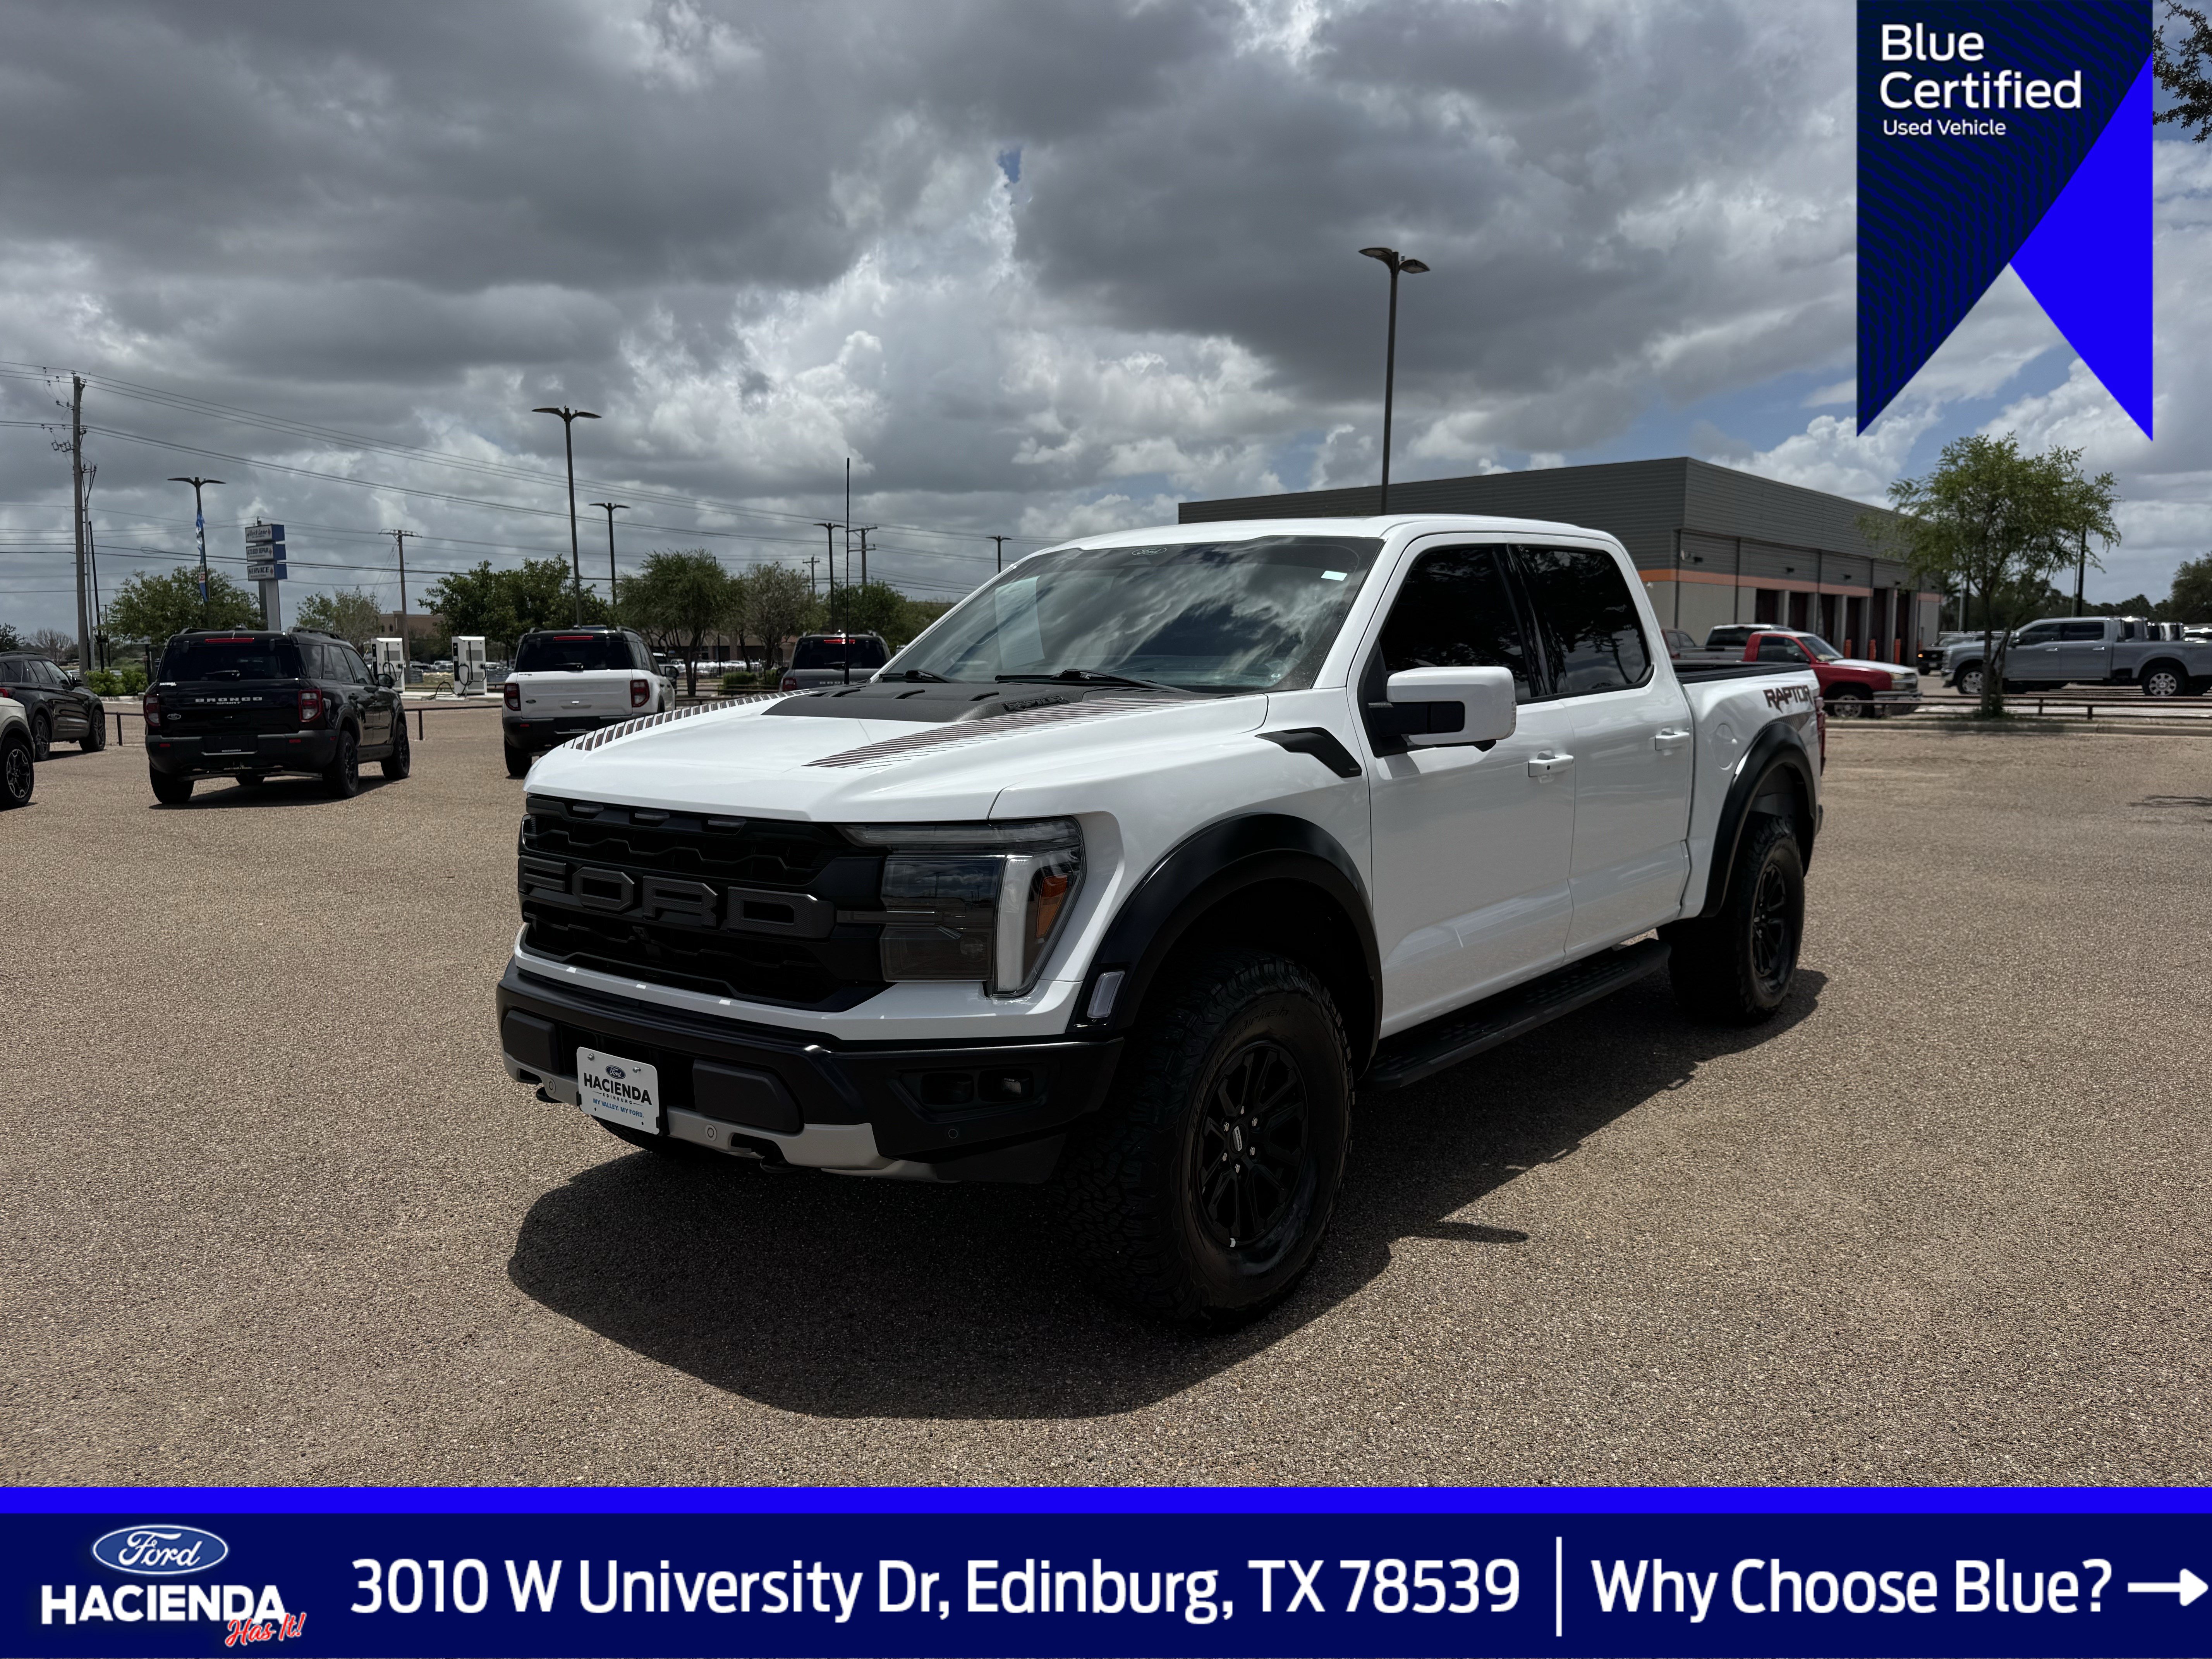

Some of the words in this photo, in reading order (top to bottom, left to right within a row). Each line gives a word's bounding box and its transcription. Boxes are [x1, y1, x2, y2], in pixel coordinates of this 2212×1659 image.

[1763, 685, 1813, 714] RAPTOR
[519, 855, 833, 939] FORD
[609, 1066, 622, 1078] Ford
[584, 1072, 652, 1106] HACIENDA
[603, 1092, 632, 1105] EDINBURG
[601, 1101, 619, 1111] VALLEY.
